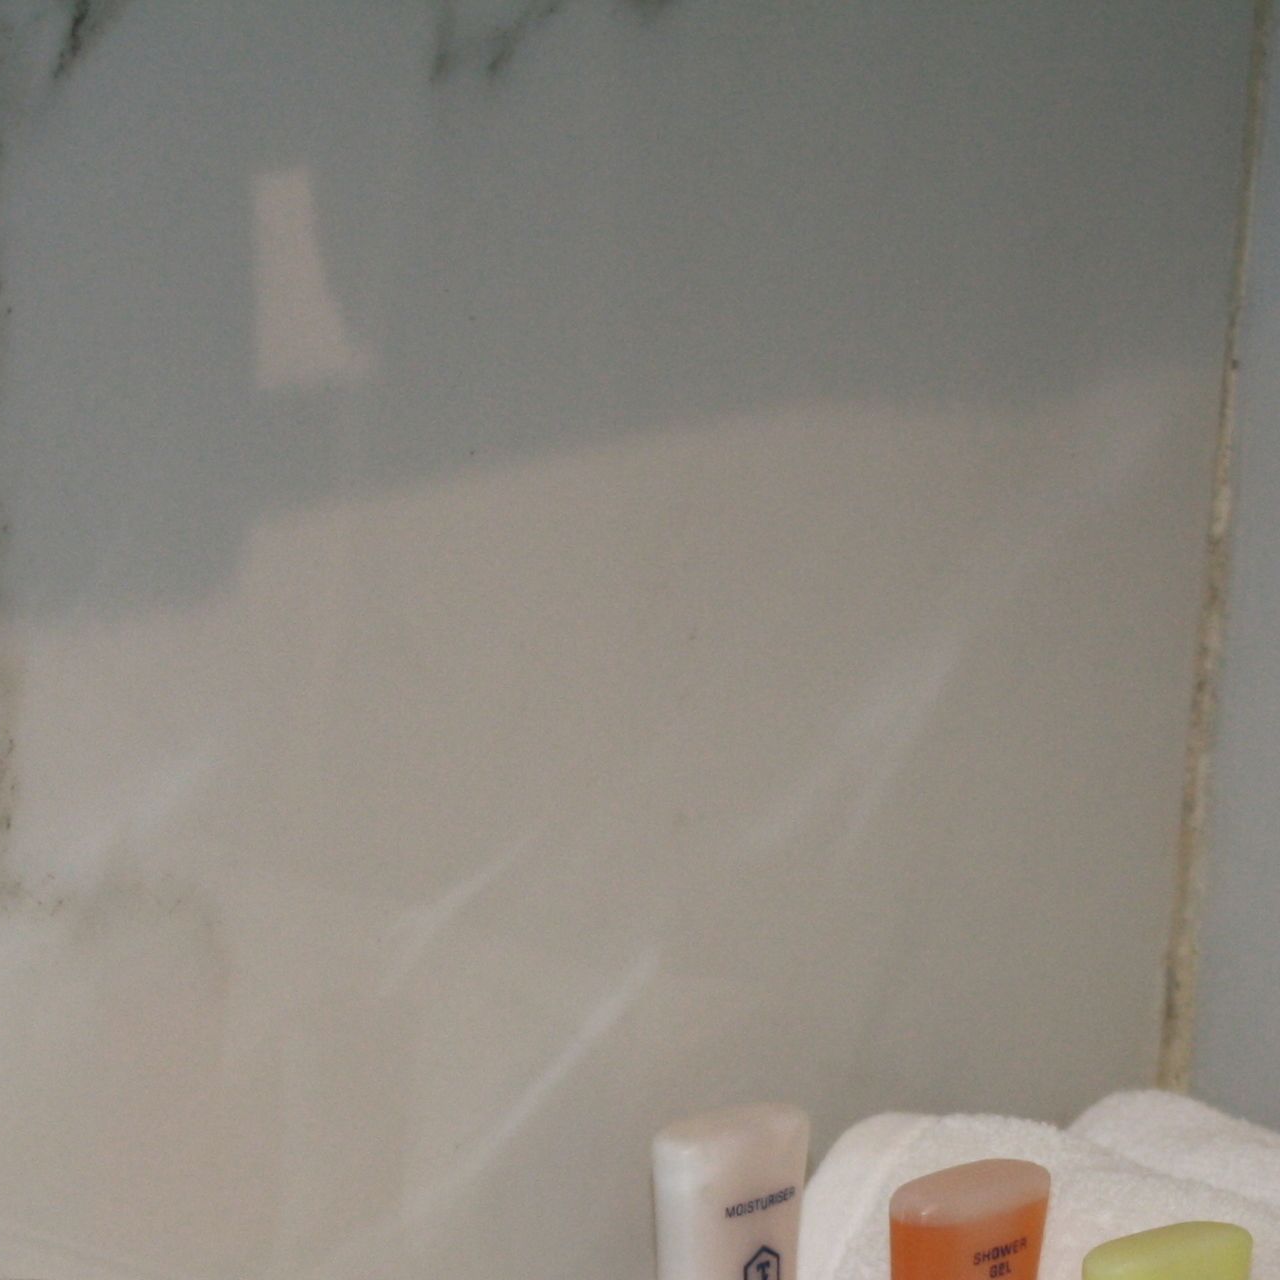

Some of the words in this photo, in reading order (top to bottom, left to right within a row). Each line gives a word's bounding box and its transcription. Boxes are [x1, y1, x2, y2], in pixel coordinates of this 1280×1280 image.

[725, 1186, 796, 1218] MOISTURISER
[973, 1237, 1027, 1266] SHOWER
[989, 1262, 1012, 1279] GEL
